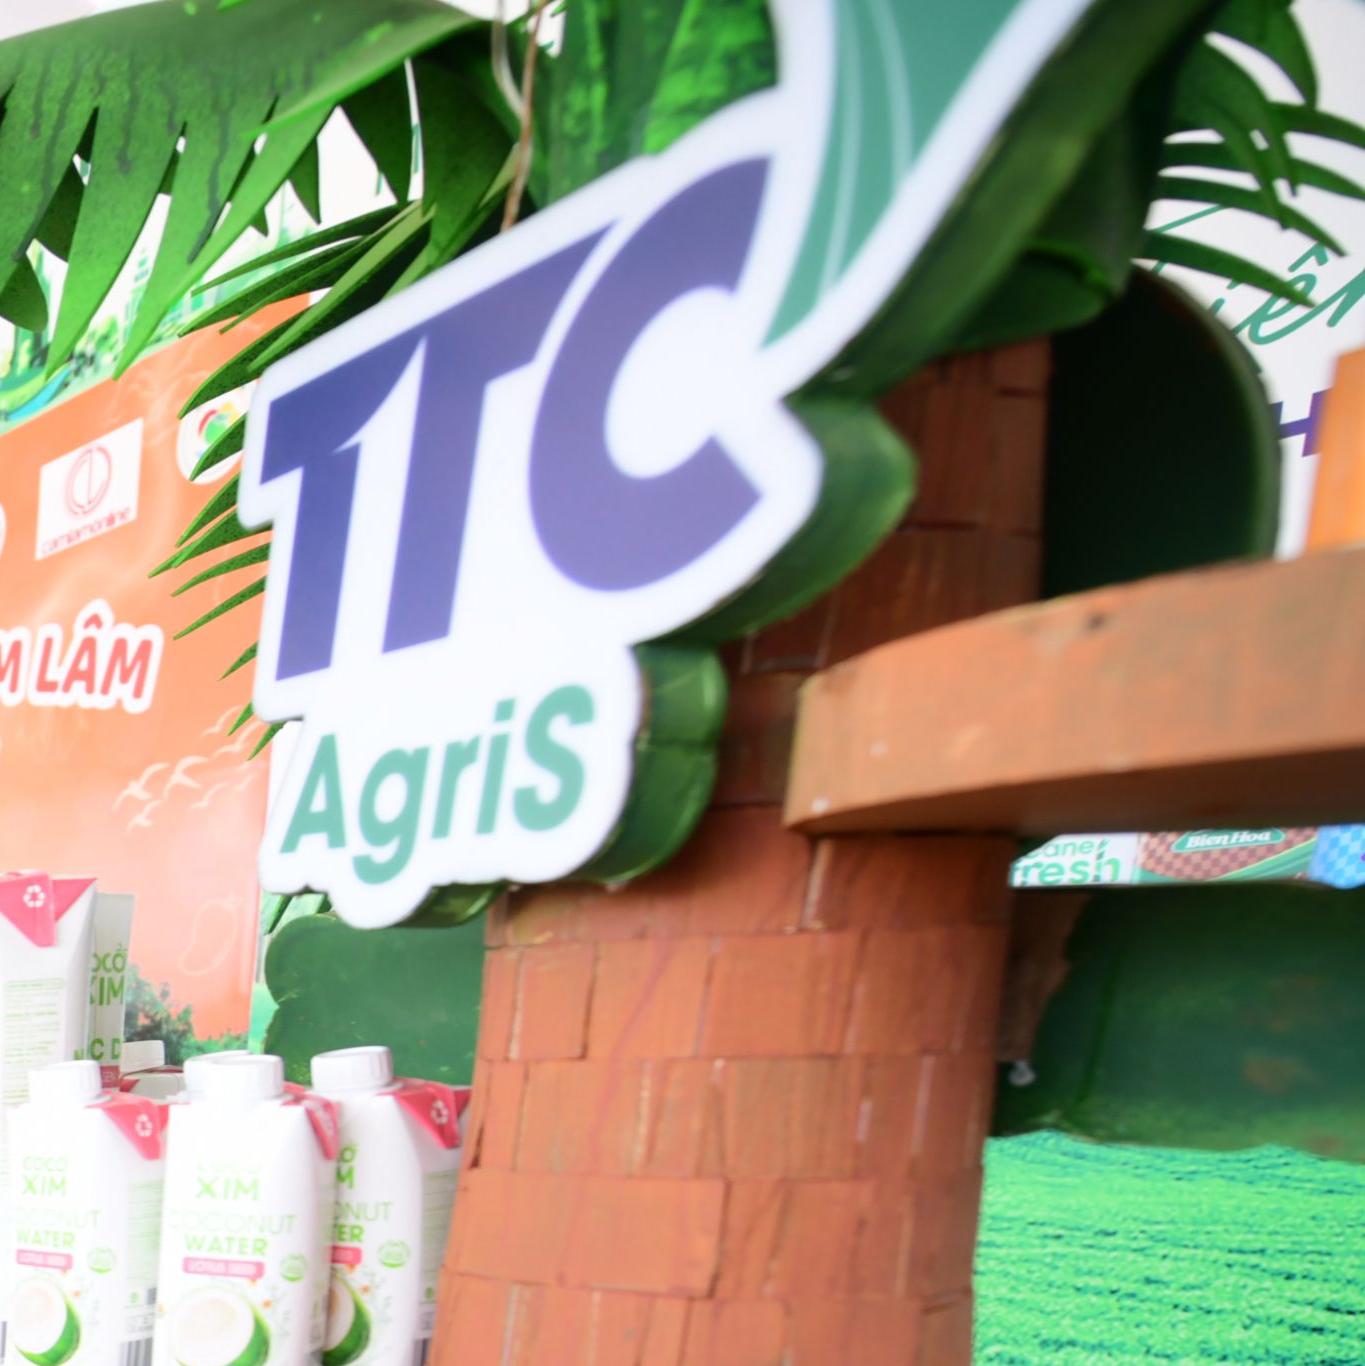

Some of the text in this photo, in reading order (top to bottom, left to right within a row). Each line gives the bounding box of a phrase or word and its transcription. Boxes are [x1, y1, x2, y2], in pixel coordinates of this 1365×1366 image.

[261, 157, 773, 681] TTC
[35, 613, 154, 700] LÂM
[278, 684, 597, 885] AgriS
[22, 1174, 67, 1197] XIM
[196, 1176, 261, 1201] XIM
[16, 1230, 76, 1250] WATER
[184, 1235, 268, 1256] WATER
